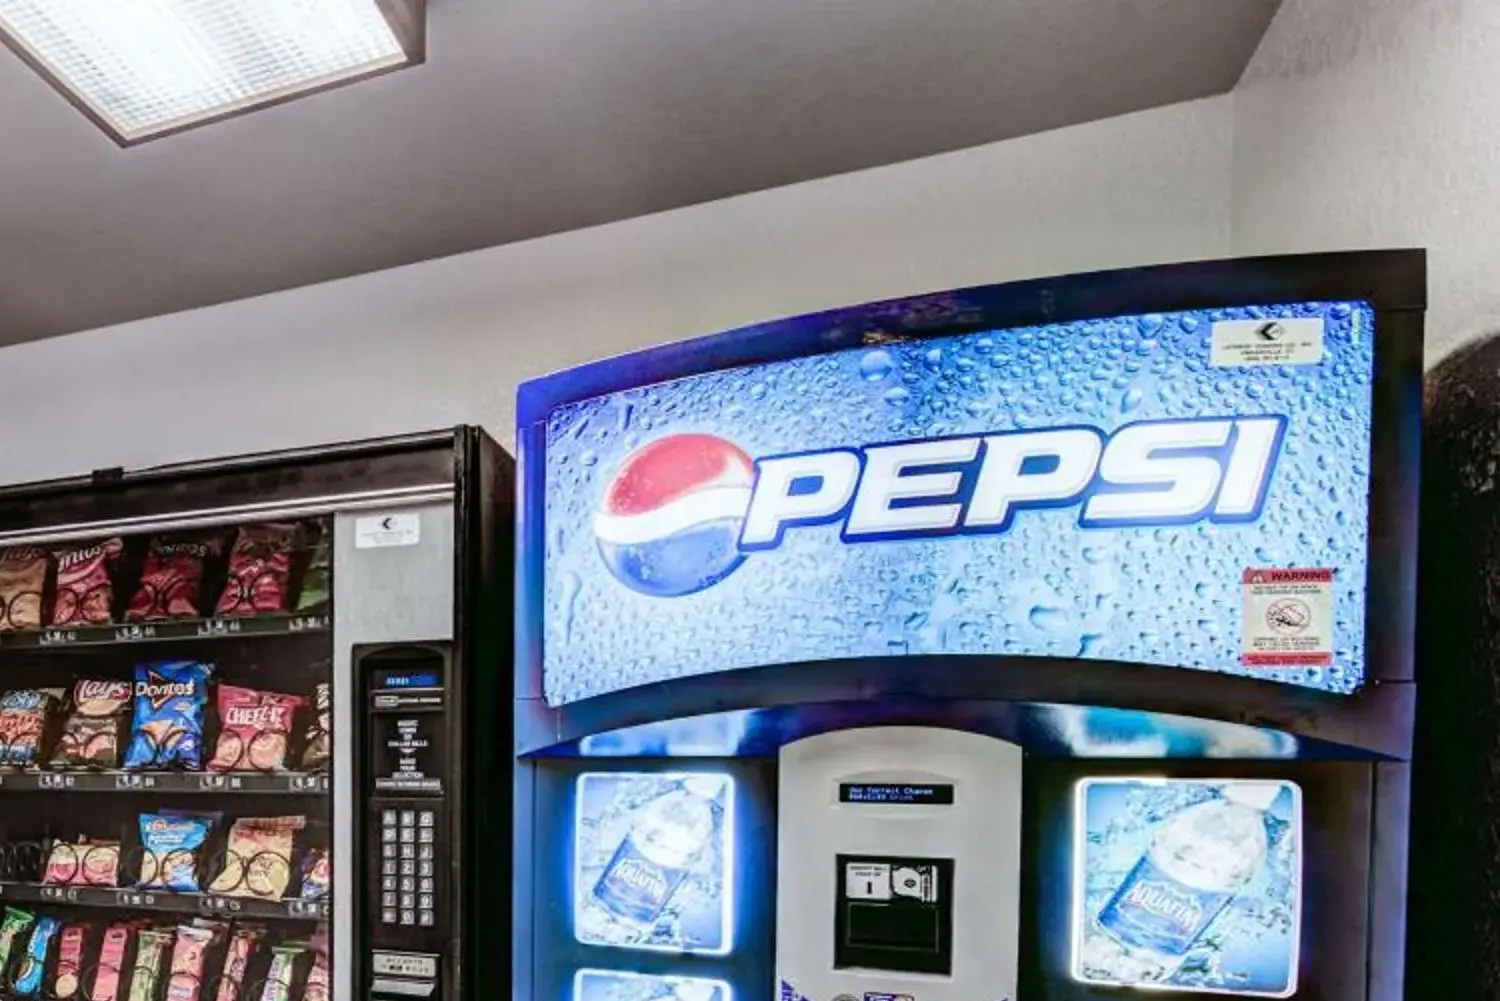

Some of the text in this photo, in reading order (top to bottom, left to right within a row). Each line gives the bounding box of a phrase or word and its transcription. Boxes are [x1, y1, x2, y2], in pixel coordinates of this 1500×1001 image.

[739, 416, 1286, 550] PEPSI
[1271, 571, 1330, 581] WARNING
[135, 679, 195, 696] Doritos
